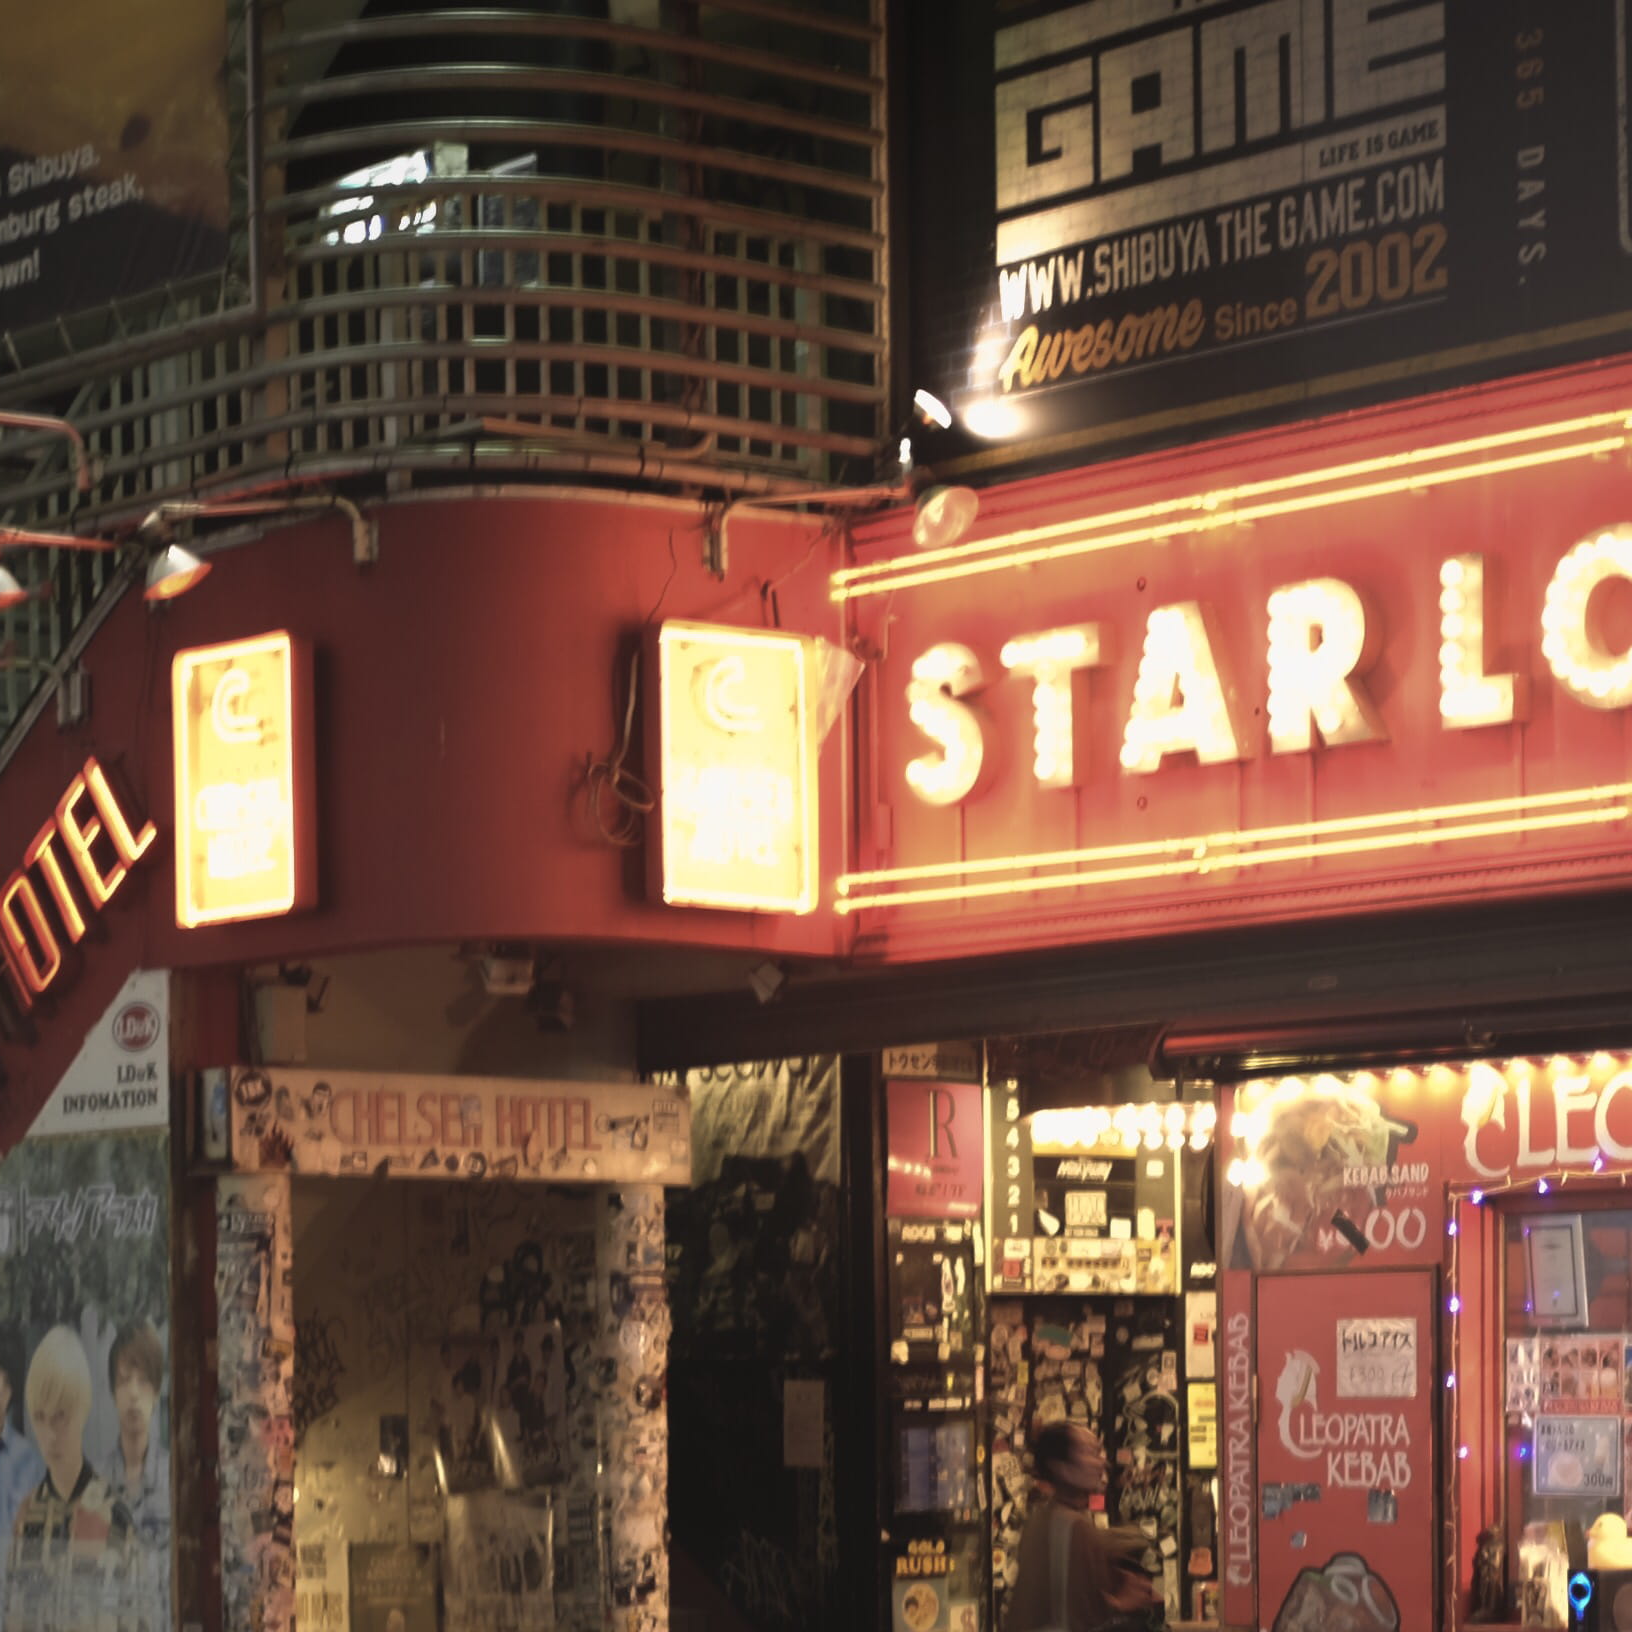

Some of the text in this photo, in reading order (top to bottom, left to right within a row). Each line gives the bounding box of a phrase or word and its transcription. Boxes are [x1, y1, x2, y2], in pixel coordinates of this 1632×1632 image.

[1515, 29, 1544, 109] 365
[995, 0, 1447, 213] GAME
[1319, 141, 1360, 169] LIFE
[1388, 120, 1438, 152] GAME
[998, 157, 1445, 323] WWW.SHIBUYA THE GAME.COM
[998, 222, 1448, 394] Awesome Since 2002
[904, 576, 1374, 808] STAR
[1007, 1155, 1020, 1178] 3
[1007, 1184, 1020, 1208] 2
[1343, 1161, 1430, 1187] KEBAB SAND
[1227, 1312, 1252, 1588] KEBAB CLEOPATRA
[1277, 1400, 1412, 1460] CLEOPATRA
[1327, 1451, 1412, 1488] KEBAB
[895, 1555, 947, 1577] RUSH
